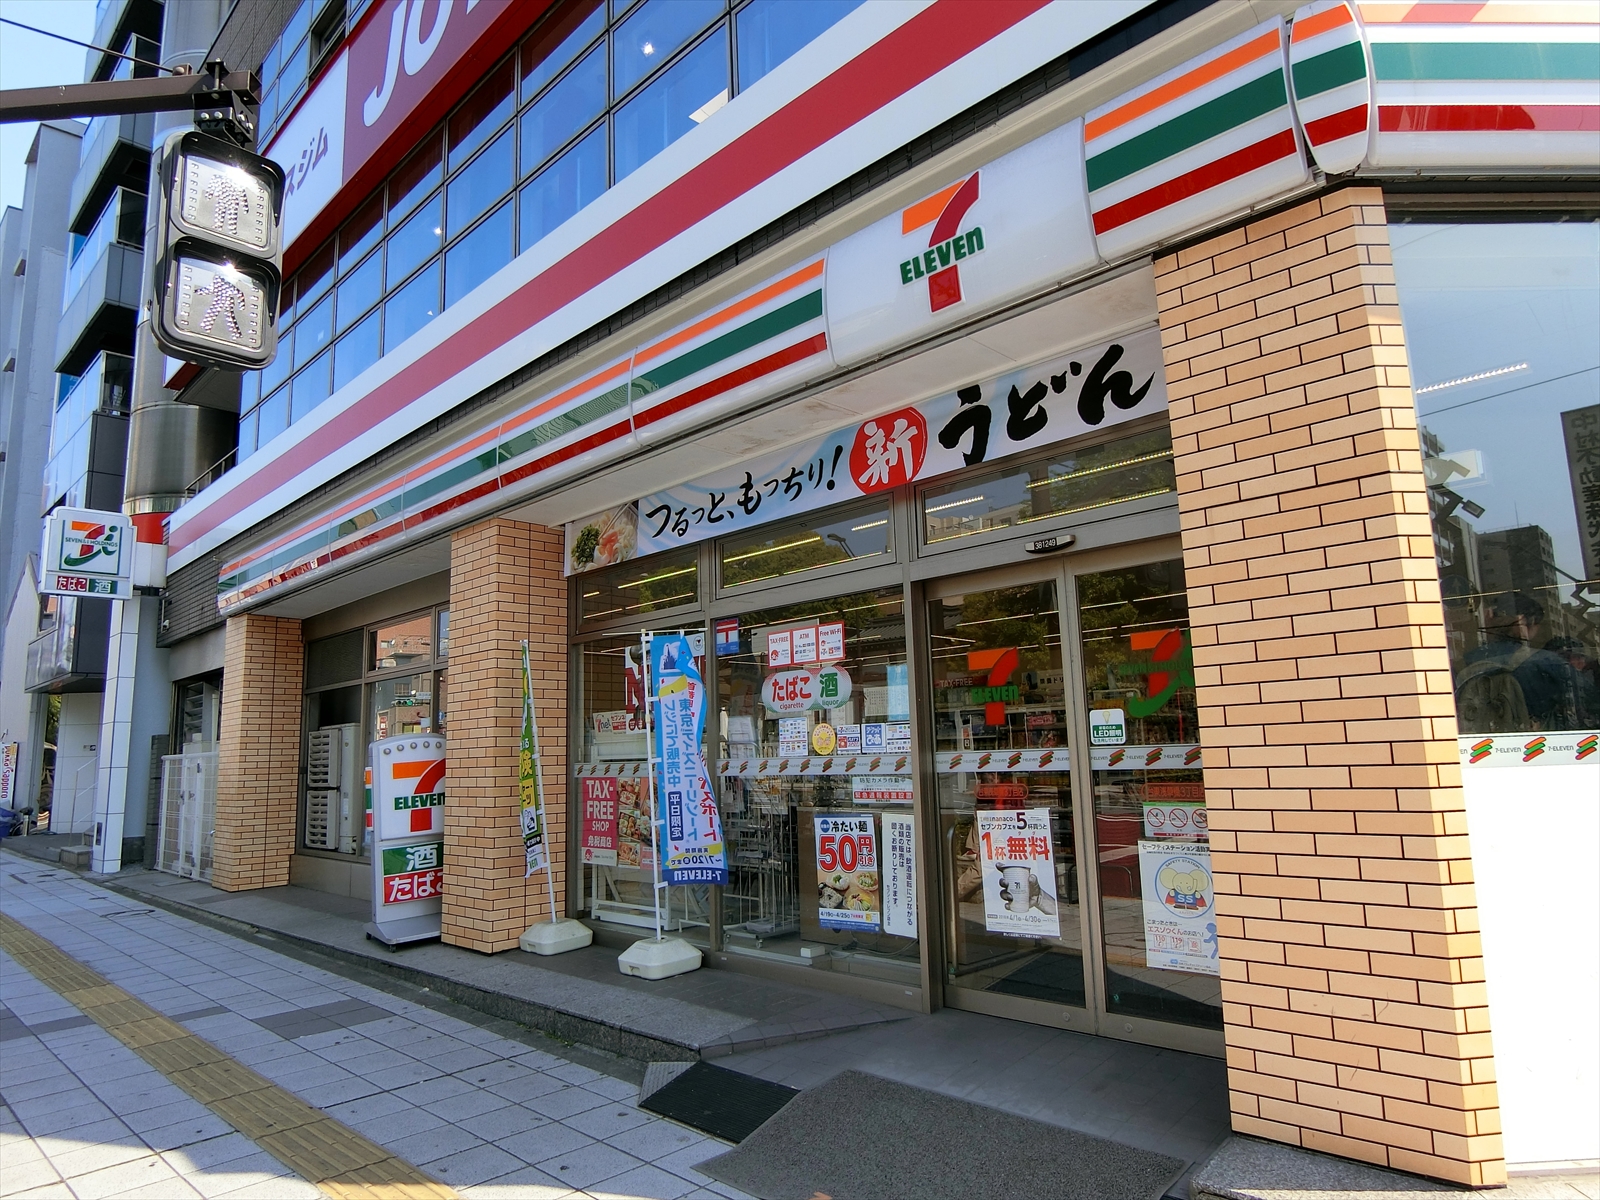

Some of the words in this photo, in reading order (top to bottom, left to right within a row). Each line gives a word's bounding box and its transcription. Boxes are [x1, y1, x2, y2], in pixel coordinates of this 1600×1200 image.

[363, 0, 481, 127] JO
[859, 418, 918, 486] 新
[938, 343, 1156, 466] うどん
[1034, 538, 1056, 550] 381249
[58, 577, 86, 592] たばこ
[94, 579, 112, 594] 酒
[771, 675, 812, 703] たばこ
[819, 672, 838, 699] 酒
[779, 701, 805, 711] cigarette
[821, 699, 839, 708] liquor
[1093, 729, 1122, 738] LED照明
[586, 780, 614, 799] TAX-
[586, 800, 614, 820] FREE
[592, 821, 610, 832] SHOP
[831, 820, 868, 833] 冷たい麺
[406, 844, 438, 872] 酒
[1165, 859, 1180, 867] SAFETY
[1177, 894, 1194, 903] SS
